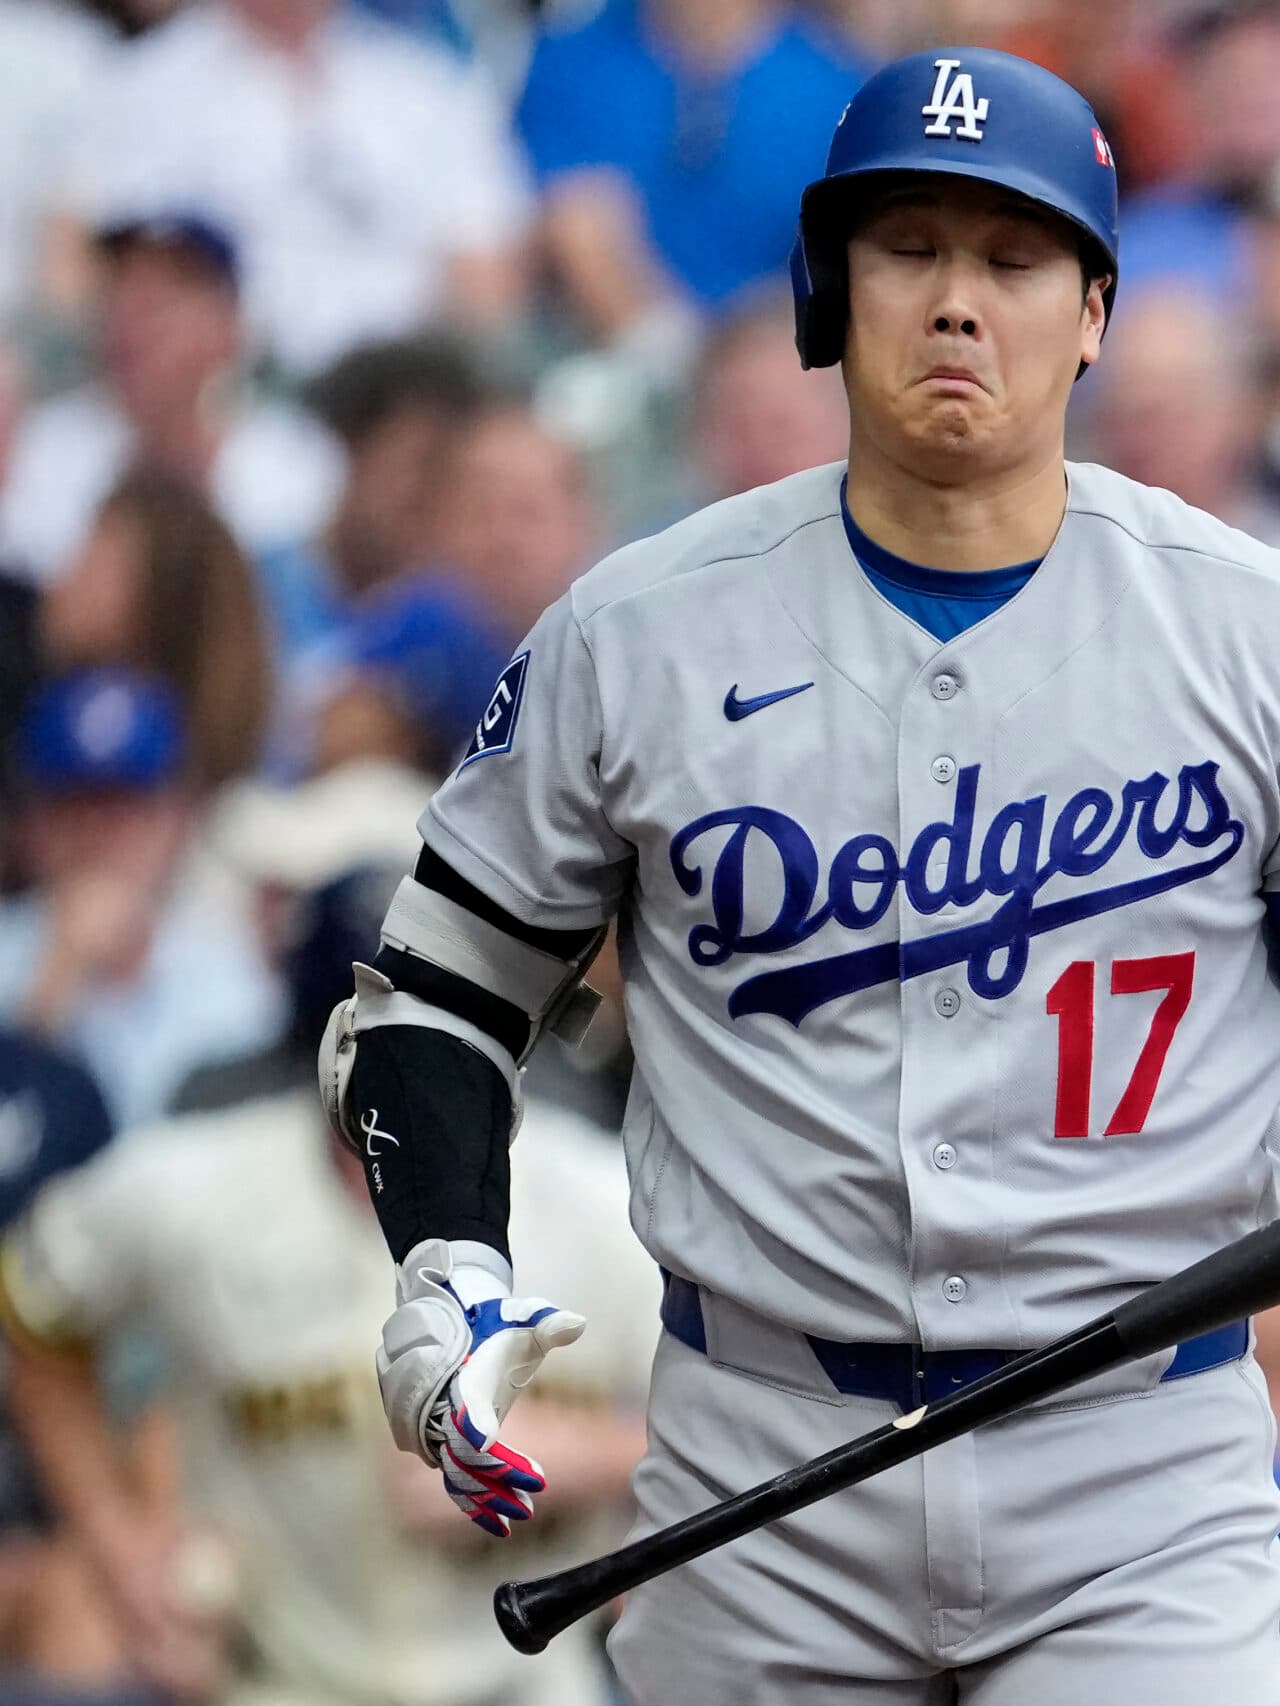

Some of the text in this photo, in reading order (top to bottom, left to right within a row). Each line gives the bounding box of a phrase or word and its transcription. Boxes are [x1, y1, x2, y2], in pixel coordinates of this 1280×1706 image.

[922, 58, 989, 140] LA
[669, 759, 1245, 1001] Dodgers
[1045, 950, 1196, 1138] 17
